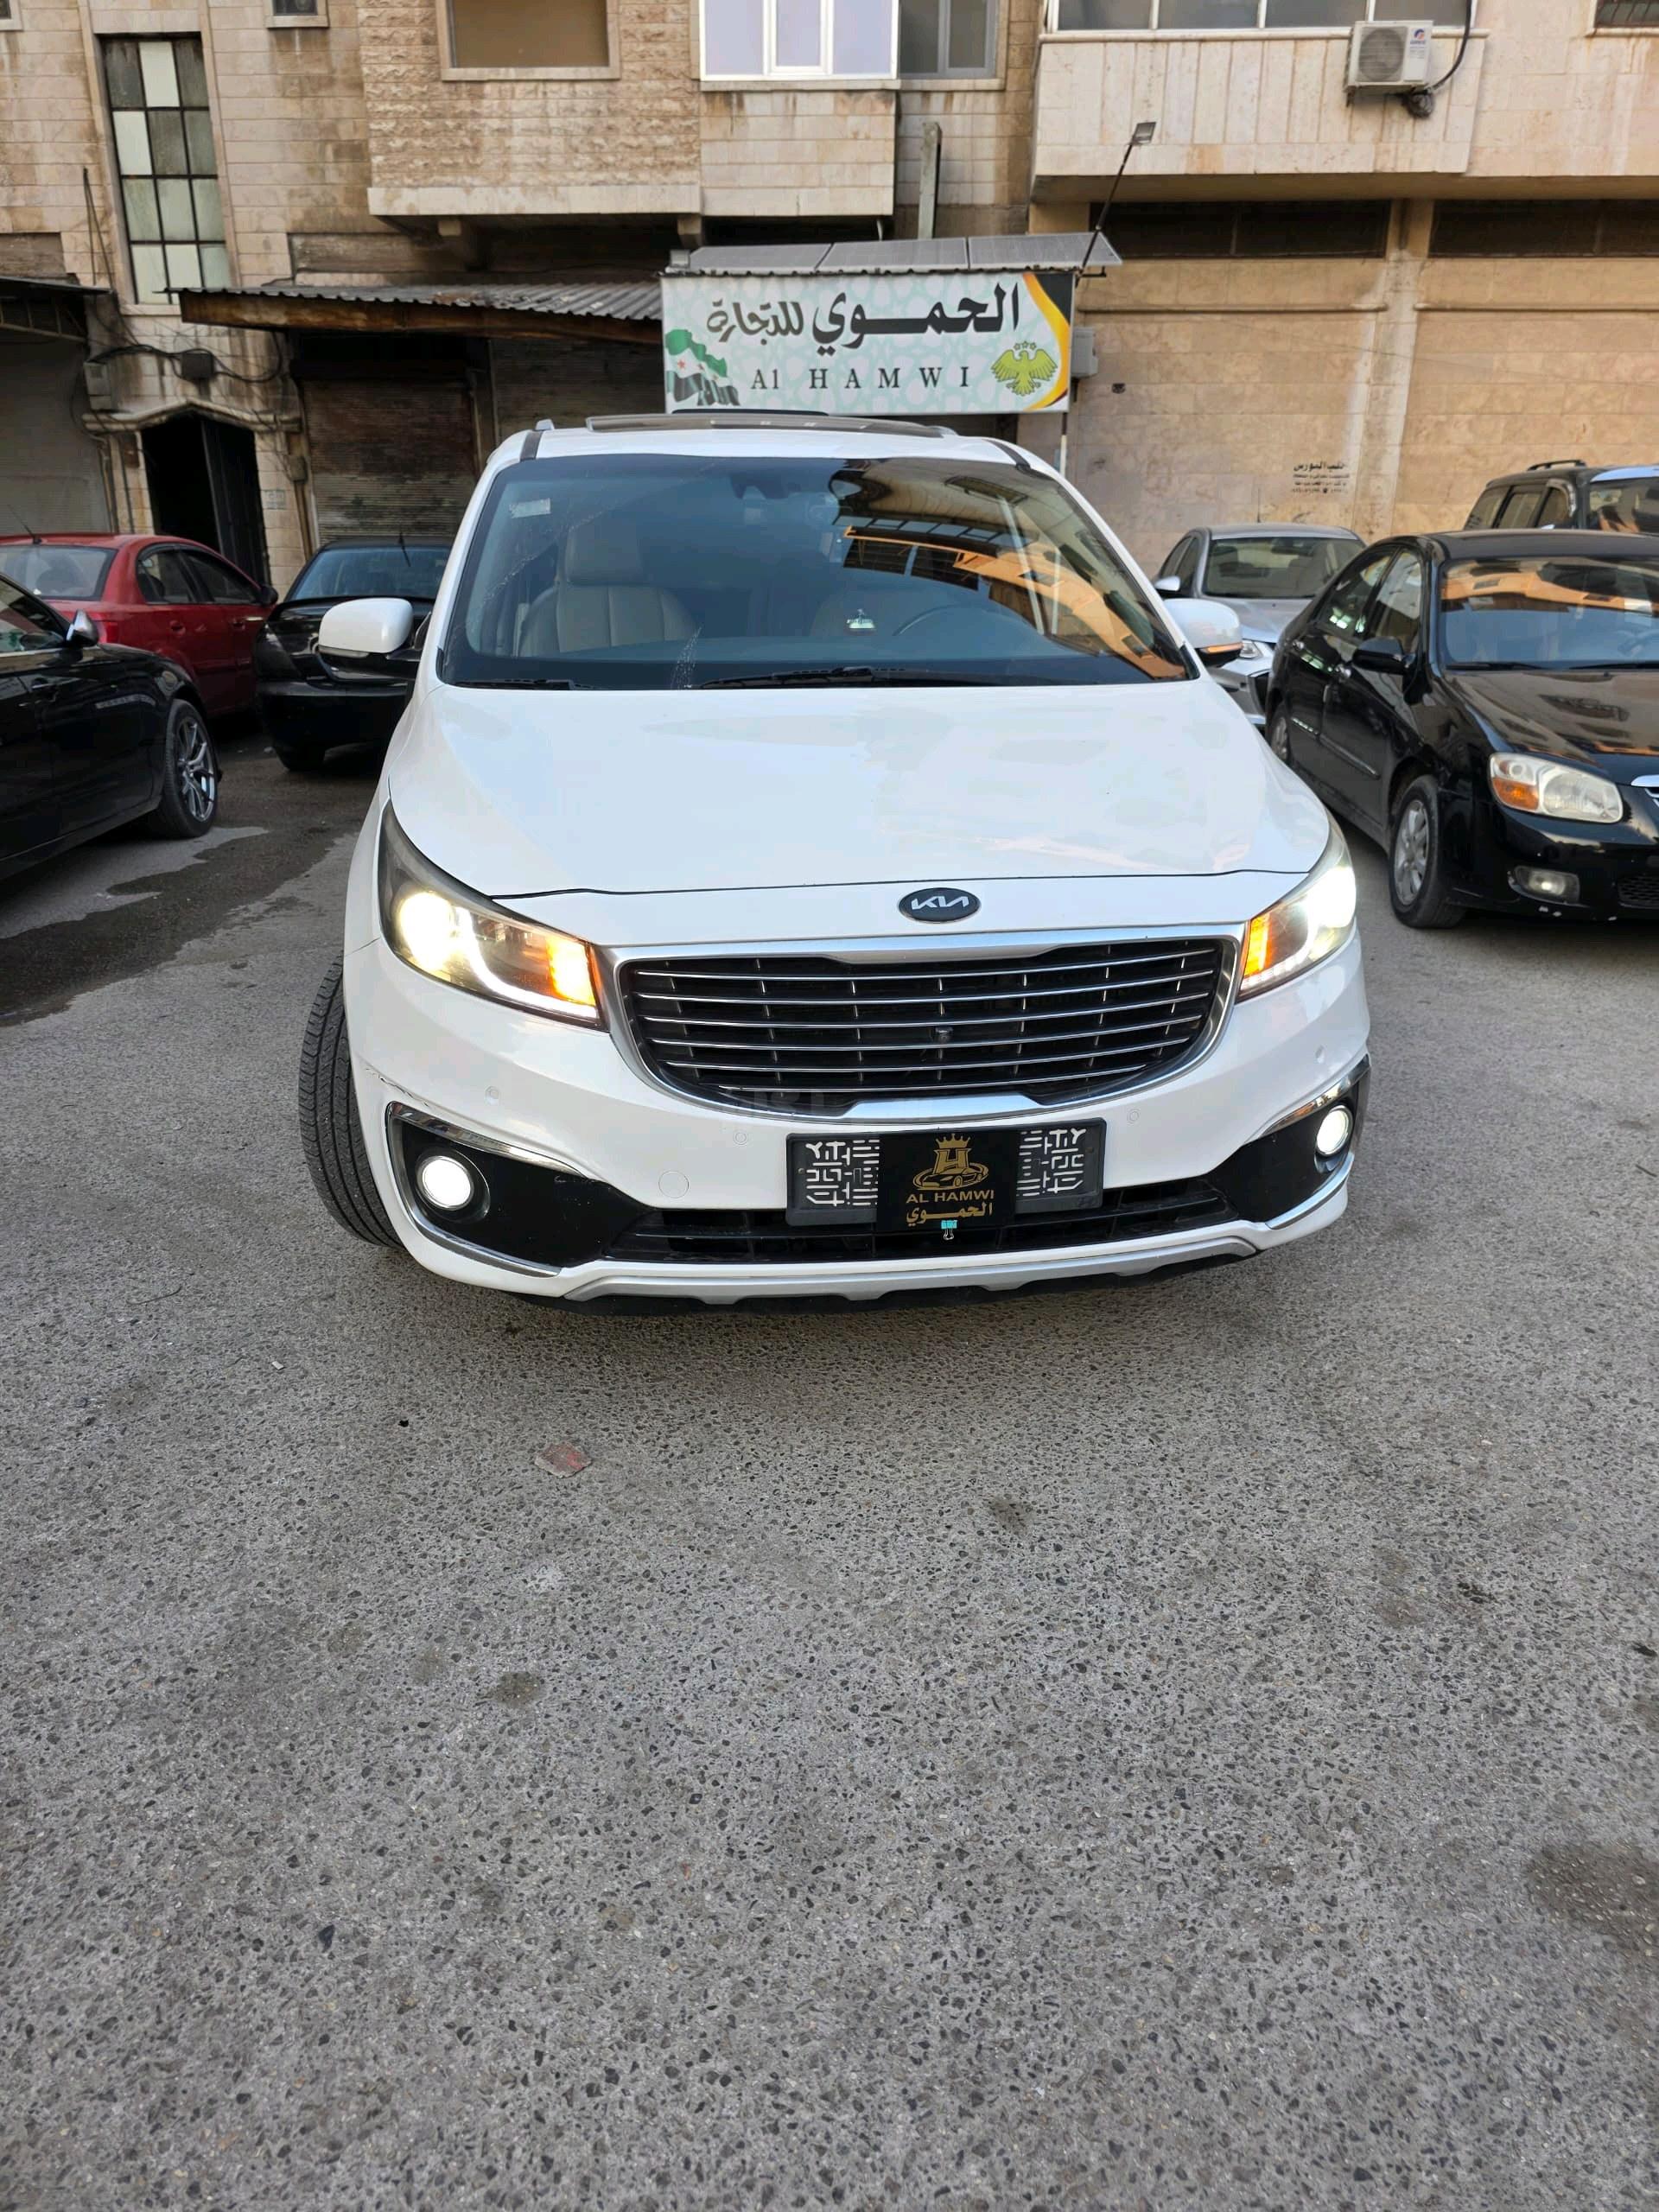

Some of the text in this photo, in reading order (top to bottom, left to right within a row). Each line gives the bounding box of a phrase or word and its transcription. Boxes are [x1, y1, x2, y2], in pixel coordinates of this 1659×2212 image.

[706, 282, 1020, 357] الحموي للتجارة
[911, 895, 969, 910] KIA
[906, 1189, 995, 1204] AL HAMWI
[906, 1201, 994, 1227] الحموي
